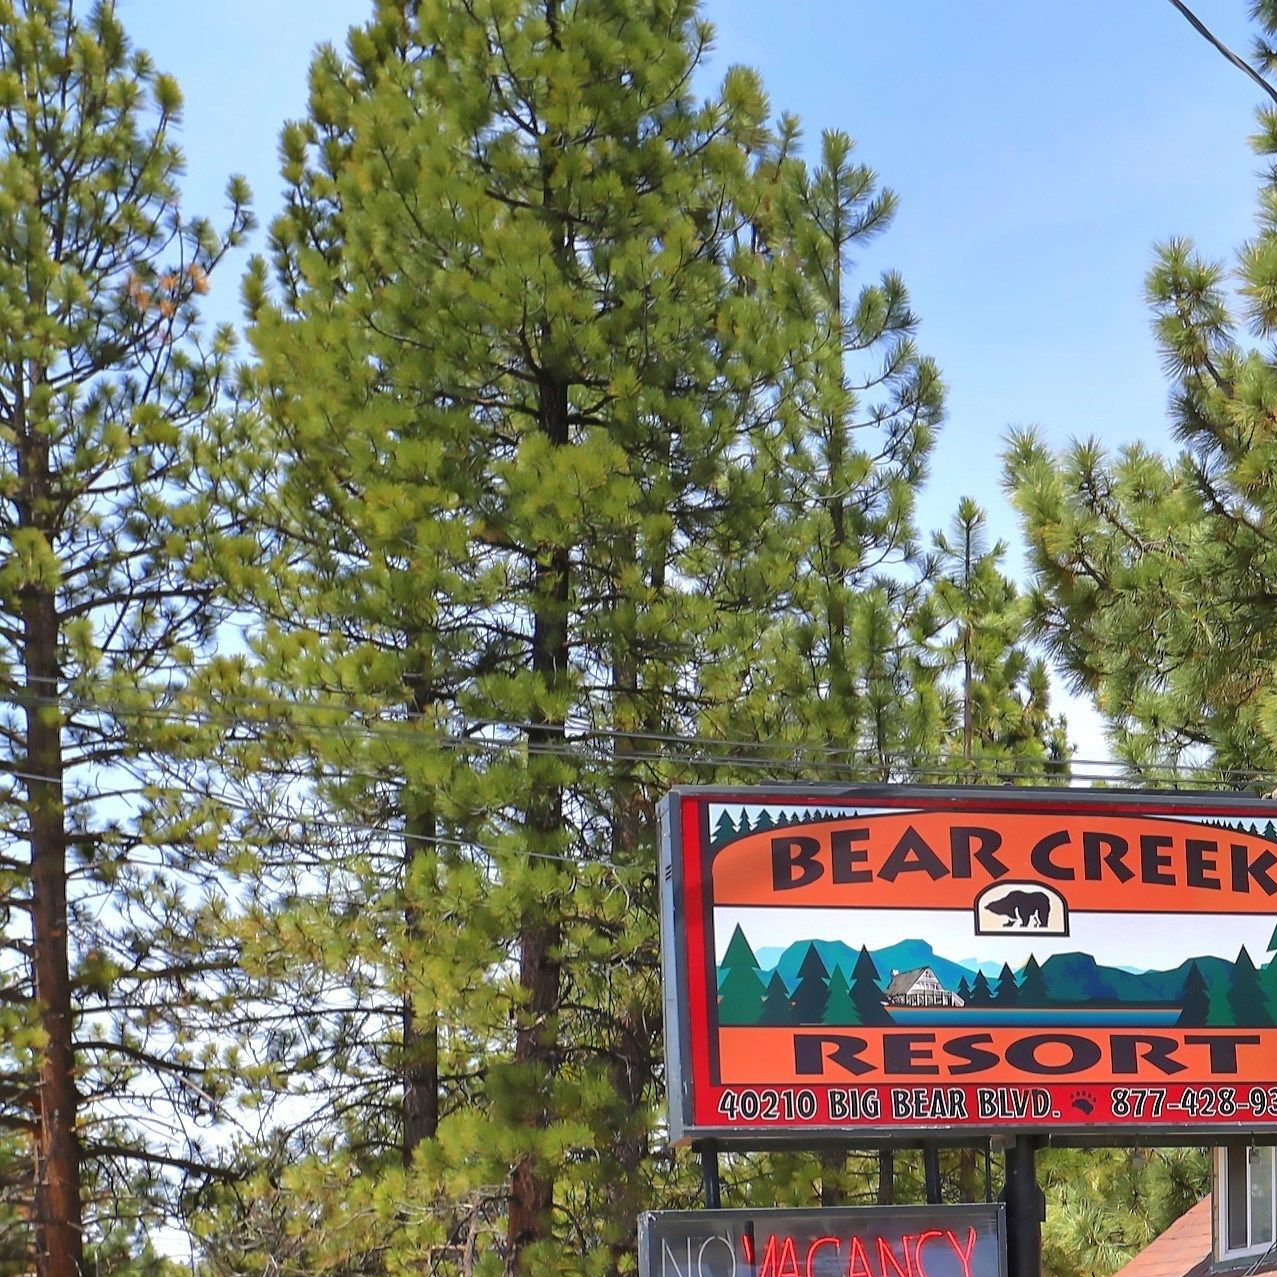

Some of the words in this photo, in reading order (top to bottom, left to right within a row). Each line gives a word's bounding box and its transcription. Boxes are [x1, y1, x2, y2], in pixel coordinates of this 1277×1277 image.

[770, 825, 1010, 891] BEAR
[793, 1033, 1261, 1076] RESORT
[718, 1087, 818, 1121] 40210
[827, 1087, 881, 1120] BIG
[890, 1087, 969, 1120] BEAR
[977, 1087, 1061, 1119] BLVD.
